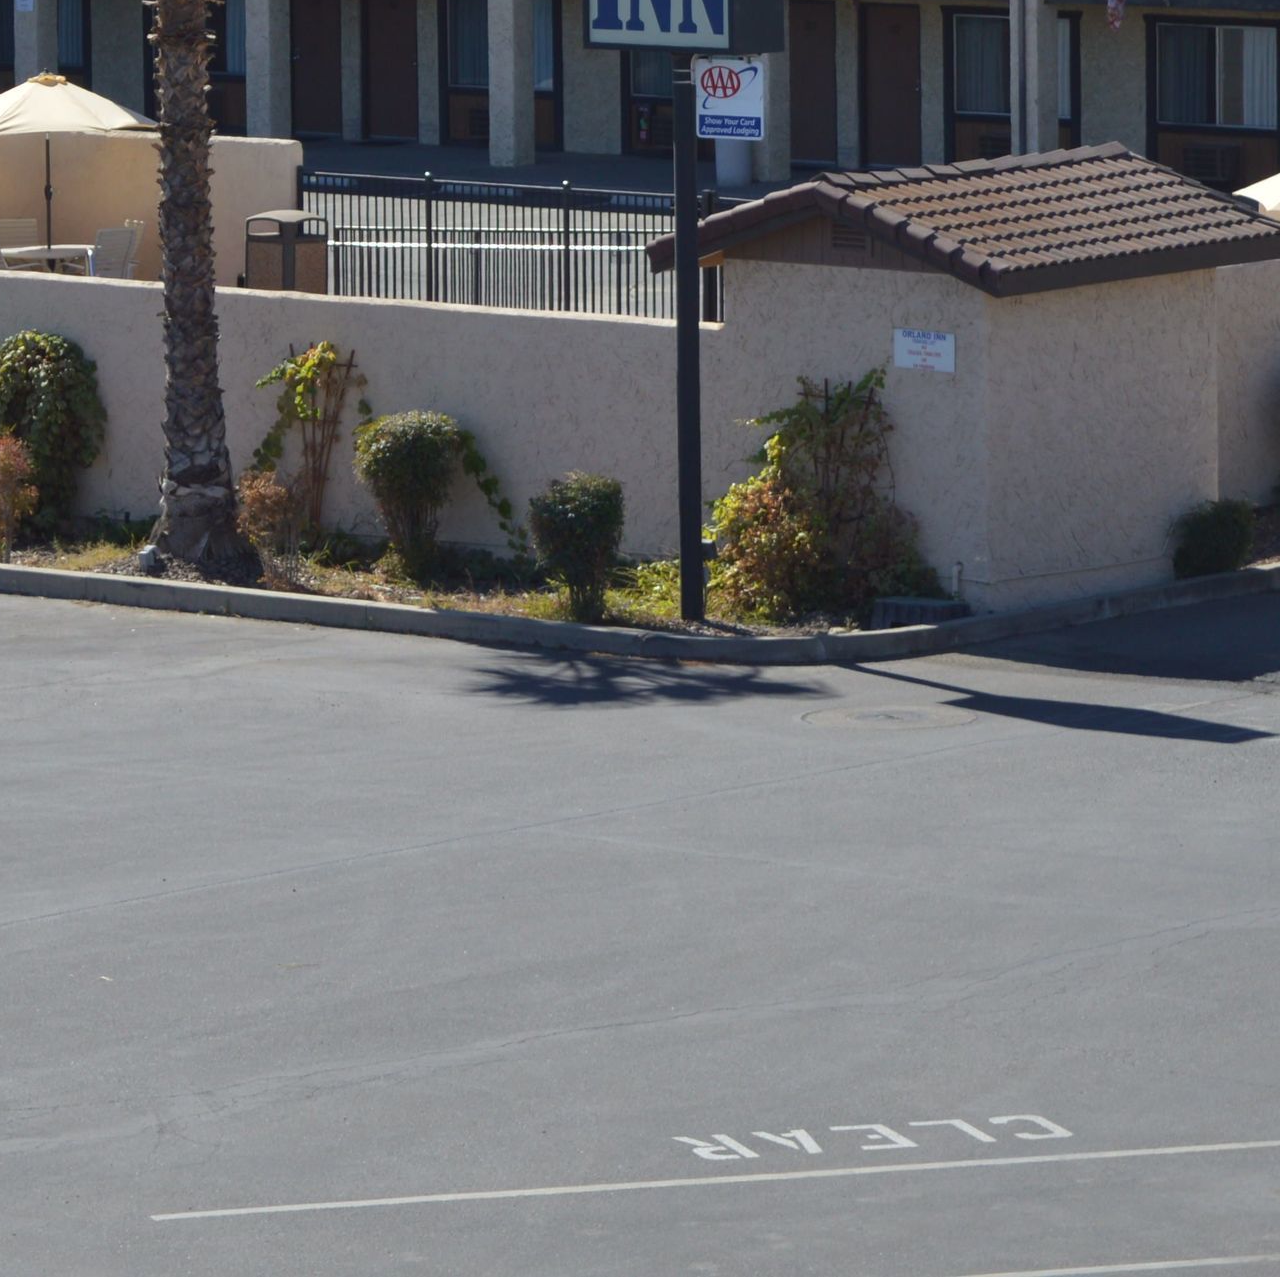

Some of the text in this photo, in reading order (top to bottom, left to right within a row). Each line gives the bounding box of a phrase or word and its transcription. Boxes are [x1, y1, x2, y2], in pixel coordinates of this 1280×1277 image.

[701, 66, 740, 98] AAA
[704, 117, 723, 125] Show
[724, 118, 738, 126] Your
[701, 126, 759, 136] Approved Lodging
[902, 330, 946, 341] ORLAND INN
[673, 1114, 1075, 1160] CLEAR
